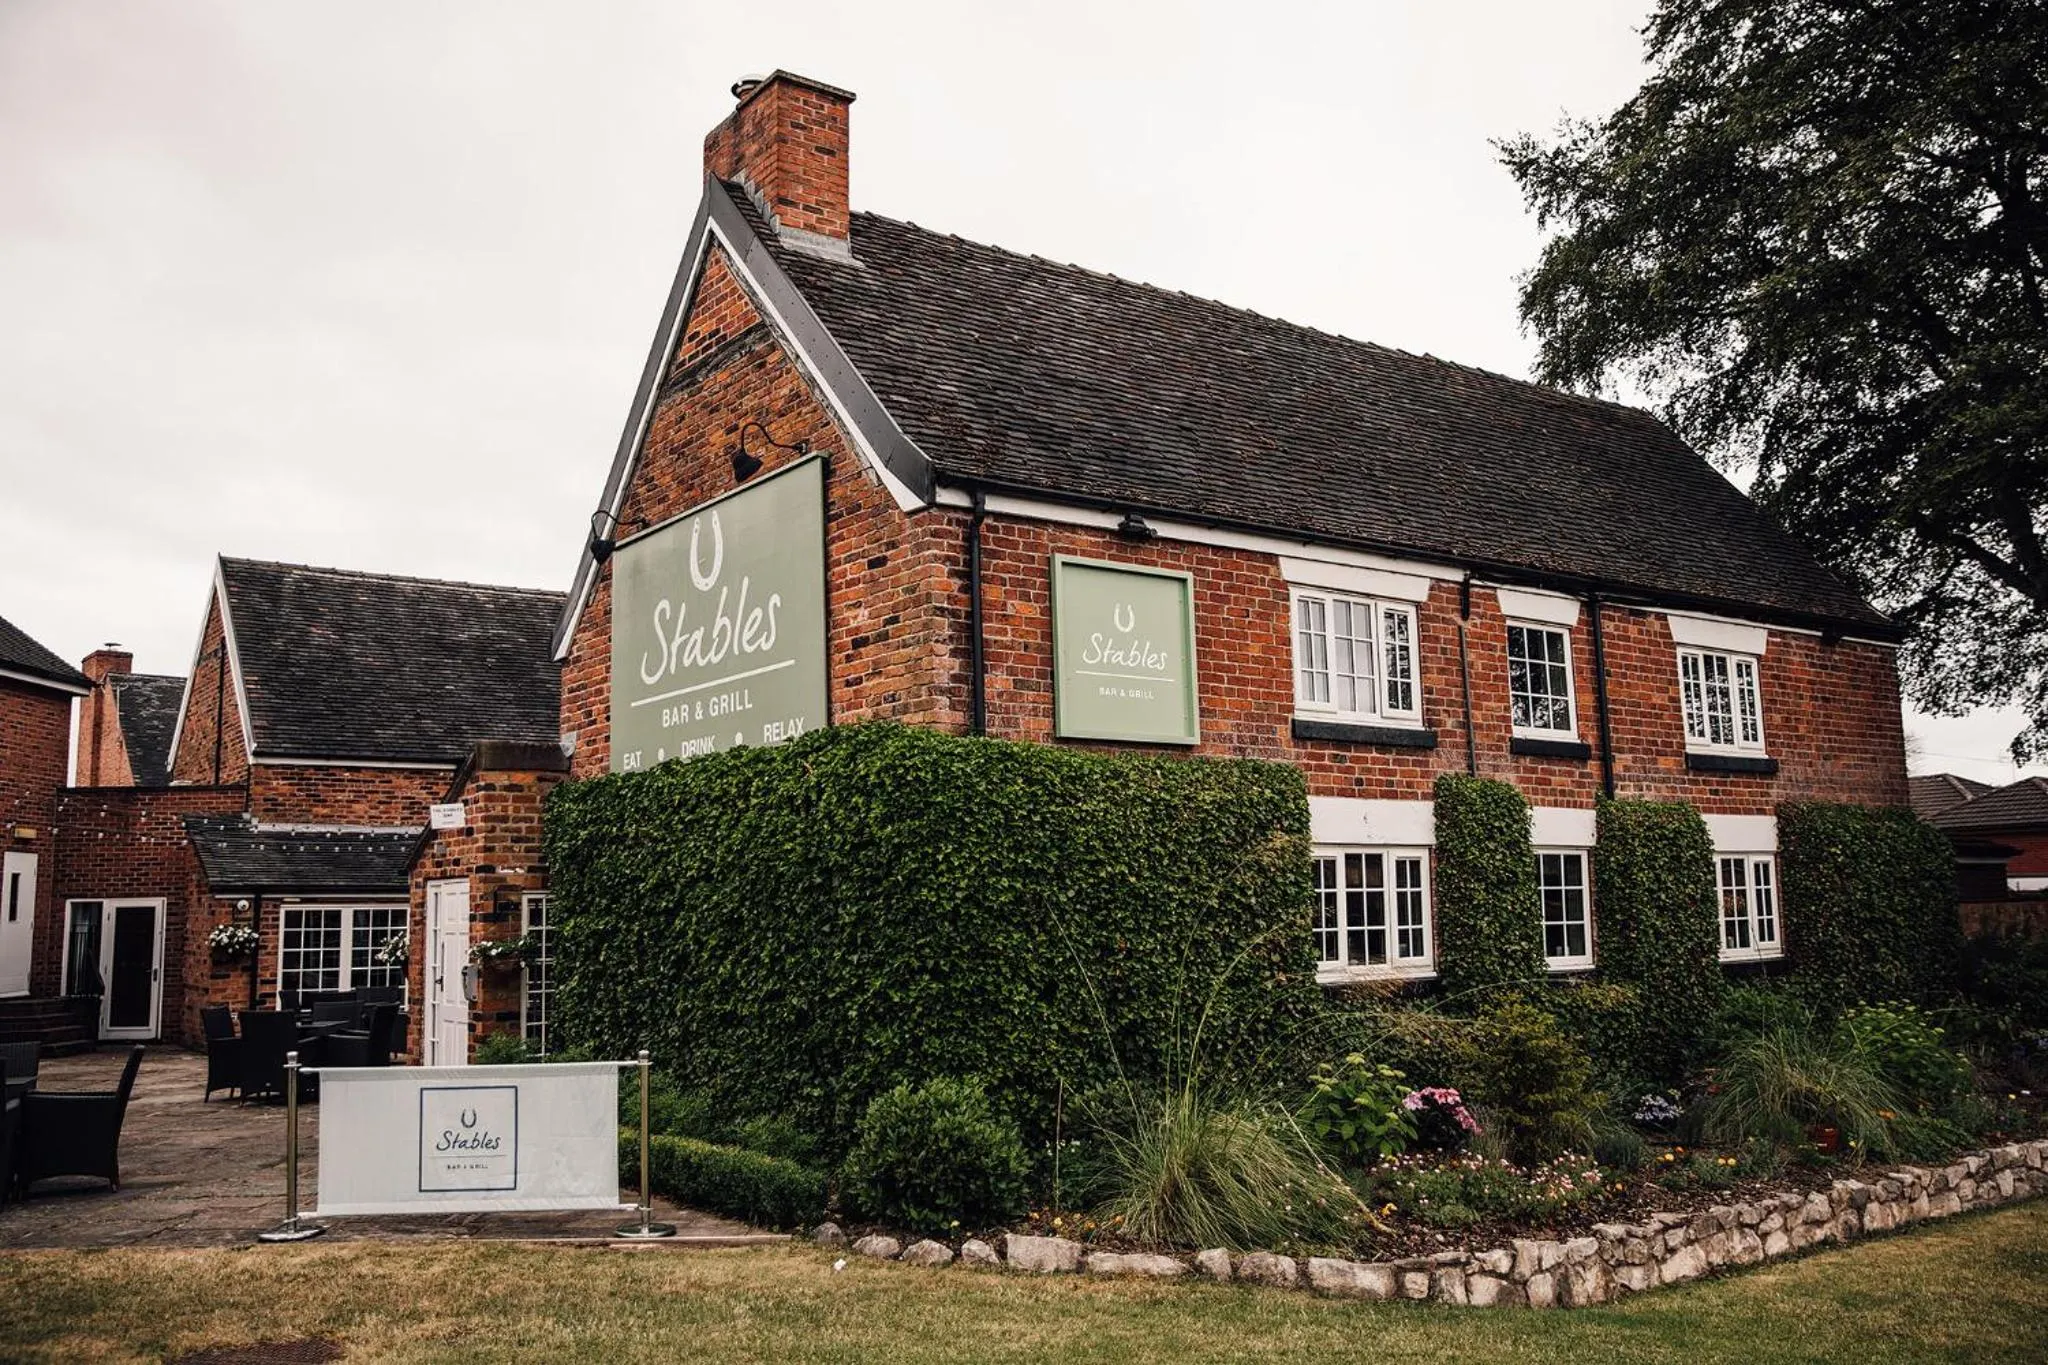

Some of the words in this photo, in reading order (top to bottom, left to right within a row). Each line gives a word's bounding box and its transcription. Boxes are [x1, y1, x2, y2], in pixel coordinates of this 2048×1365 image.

[640, 576, 781, 684] Stables
[1082, 632, 1168, 671] Stables
[662, 703, 689, 728] BAR
[695, 701, 704, 720] &
[709, 688, 753, 717] GRILL
[623, 749, 643, 771] EAT
[681, 734, 716, 759] DRINK
[763, 716, 805, 744] RELAX
[436, 1130, 501, 1151] Stables
